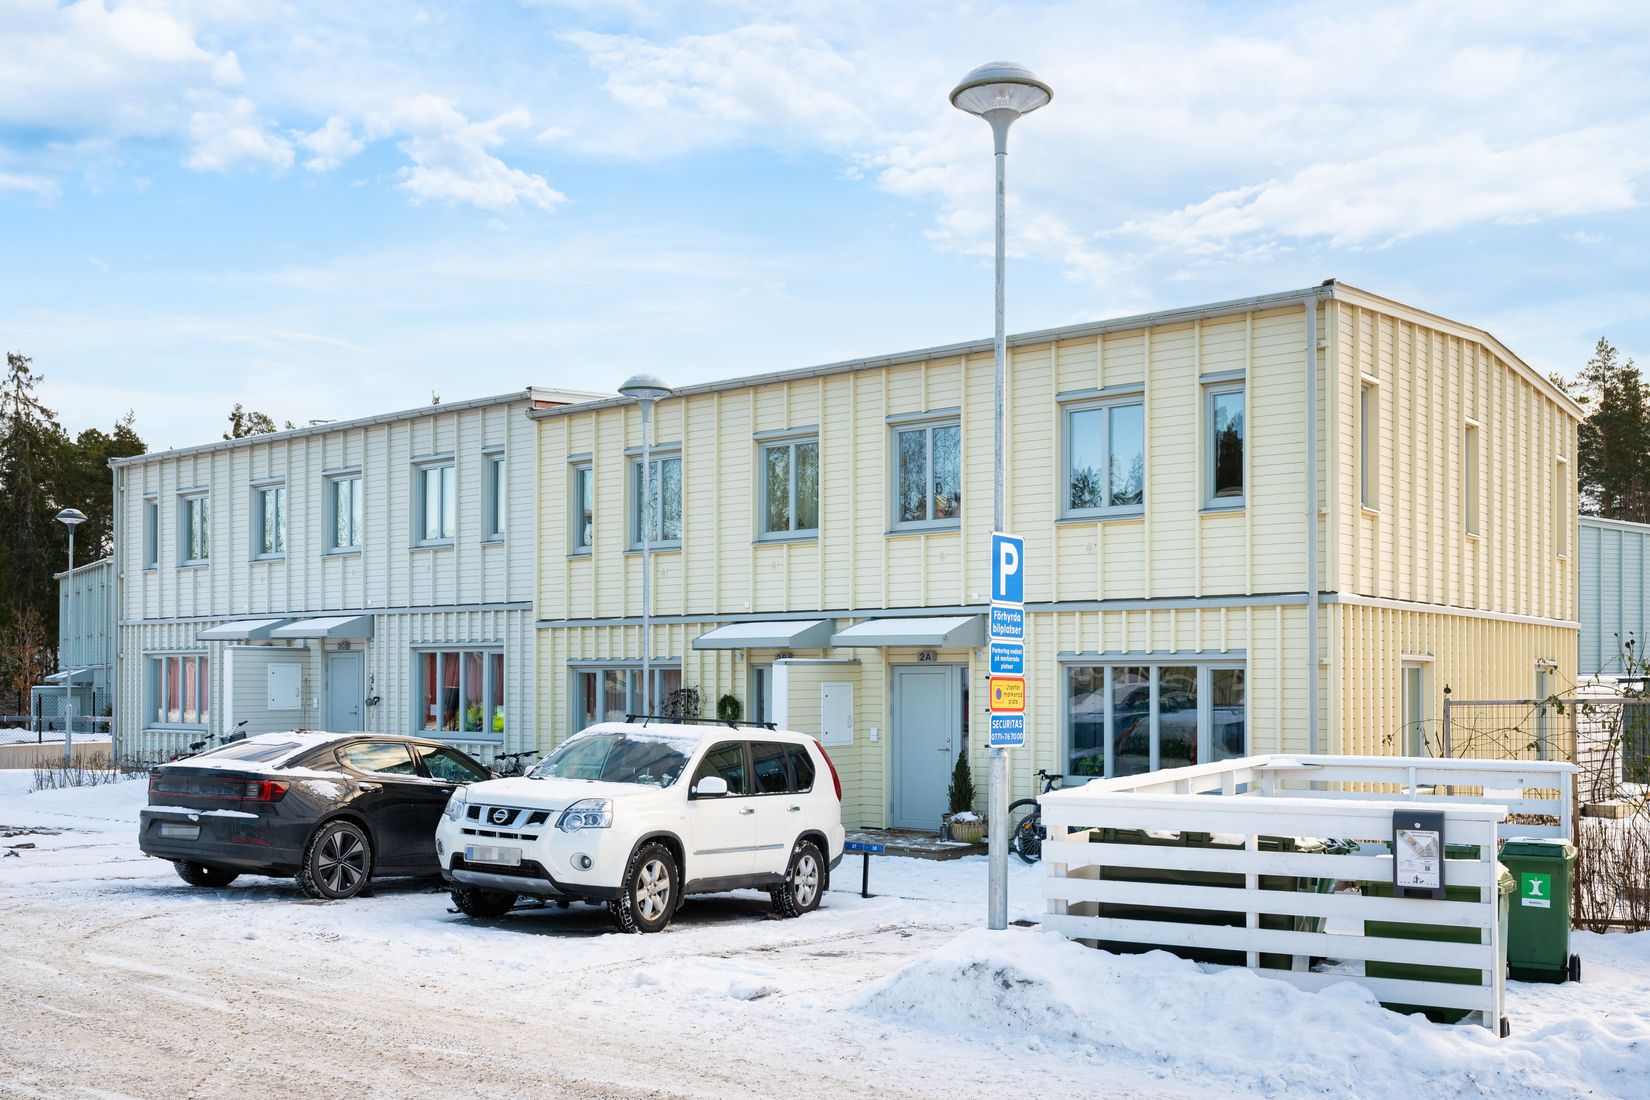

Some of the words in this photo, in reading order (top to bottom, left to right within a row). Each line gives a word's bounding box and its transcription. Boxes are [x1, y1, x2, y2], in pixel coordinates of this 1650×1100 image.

[1000, 541, 1019, 595] P
[994, 610, 1021, 623] Förhyrda
[992, 623, 1022, 635] bilplatser
[919, 652, 932, 661] 2A
[992, 719, 1023, 729] SECURITAS
